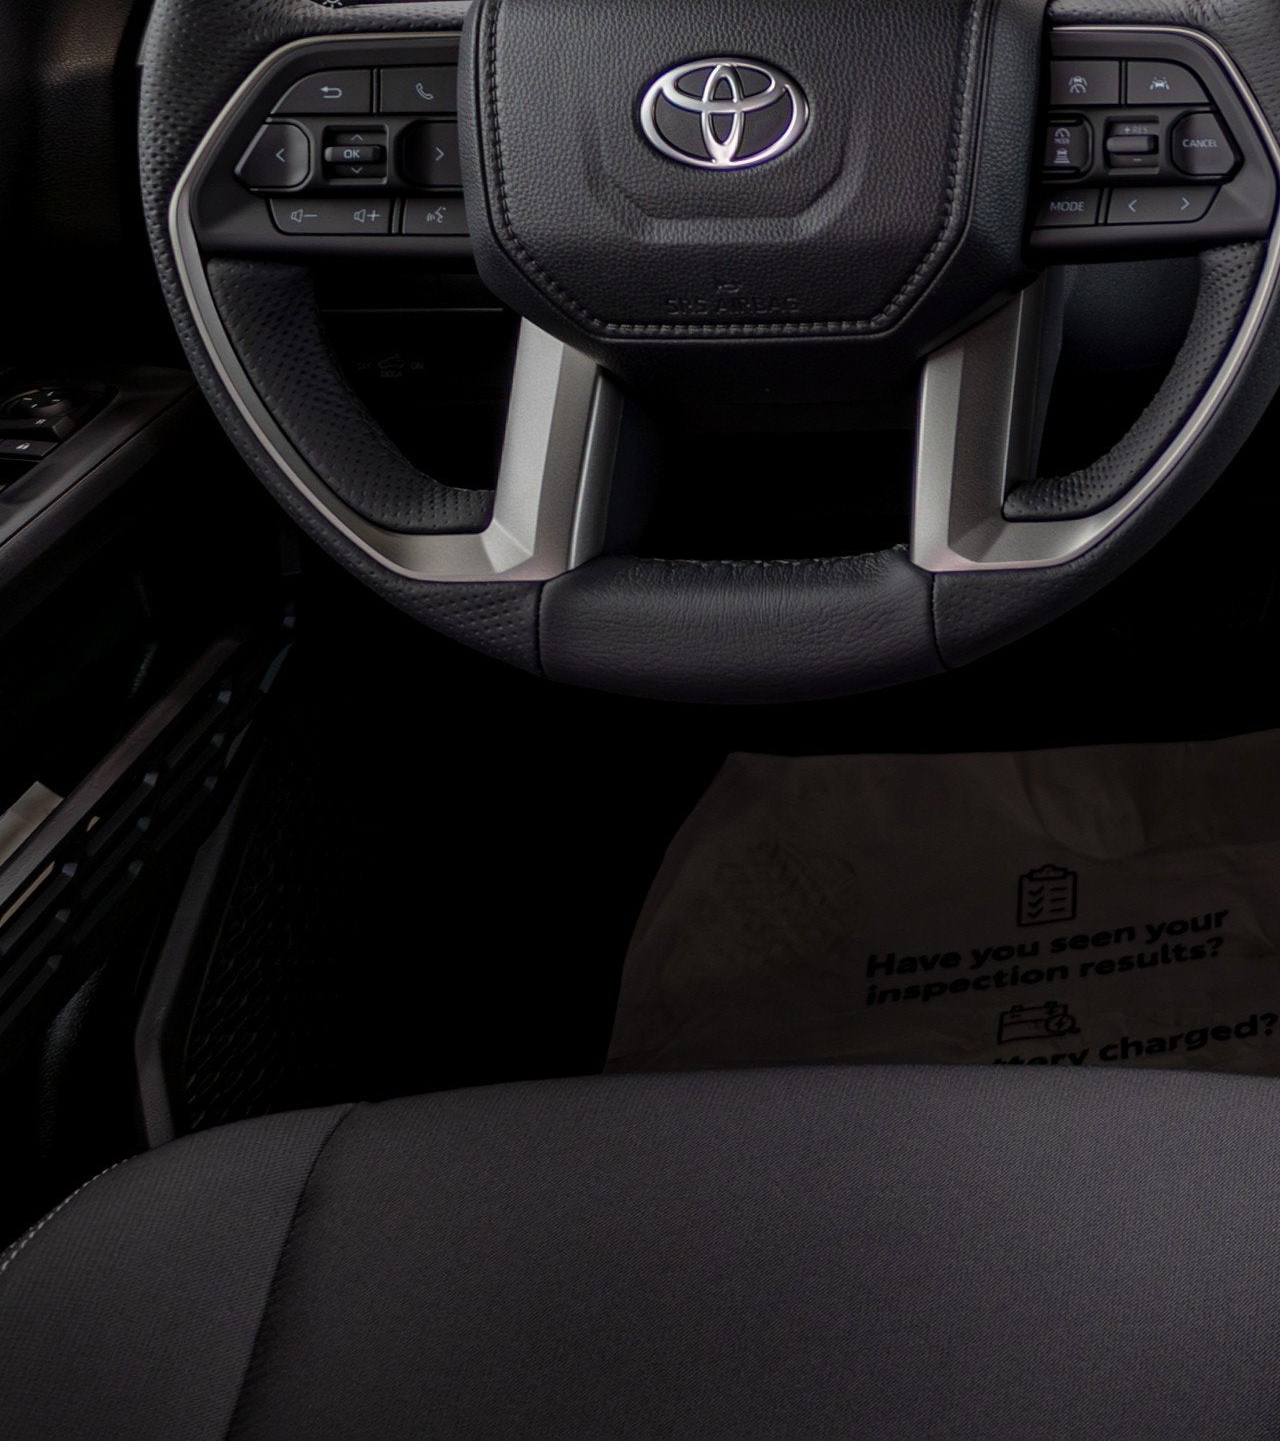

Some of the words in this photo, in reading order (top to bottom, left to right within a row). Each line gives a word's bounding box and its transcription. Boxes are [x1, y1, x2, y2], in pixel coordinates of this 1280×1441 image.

[343, 149, 360, 158] OK
[1182, 139, 1218, 148] CANCEL
[1050, 202, 1085, 211] MODE
[866, 948, 961, 980] Have
[970, 940, 1041, 970] you
[1050, 926, 1136, 954] seen
[1145, 908, 1230, 944] your
[865, 963, 1069, 1008] inspection
[1079, 935, 1225, 979] results?
[1099, 1012, 1279, 1064] charged?
